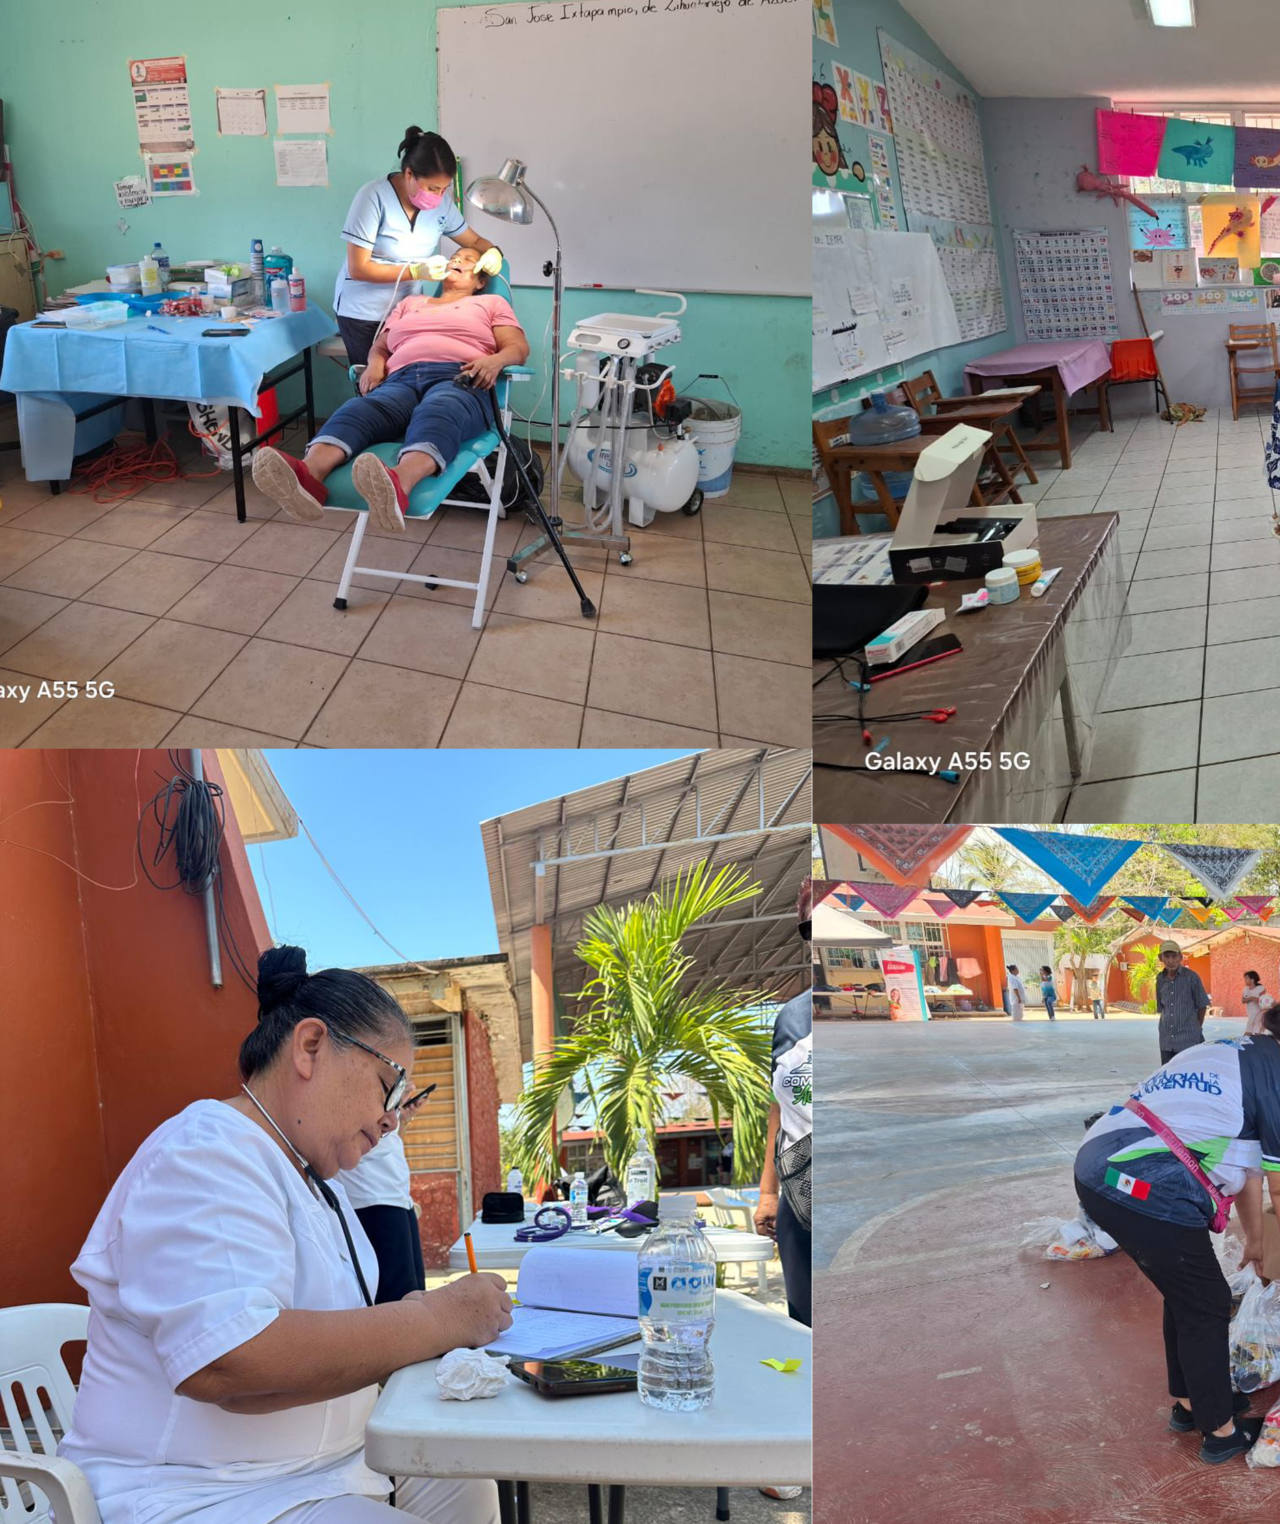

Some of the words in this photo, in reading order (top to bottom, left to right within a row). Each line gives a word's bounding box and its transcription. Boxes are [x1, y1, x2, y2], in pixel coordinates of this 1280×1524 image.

[485, 8, 517, 28] San
[641, 3, 658, 13] de
[1200, 292, 1221, 300] 300
[1209, 1072, 1220, 1080] DE
